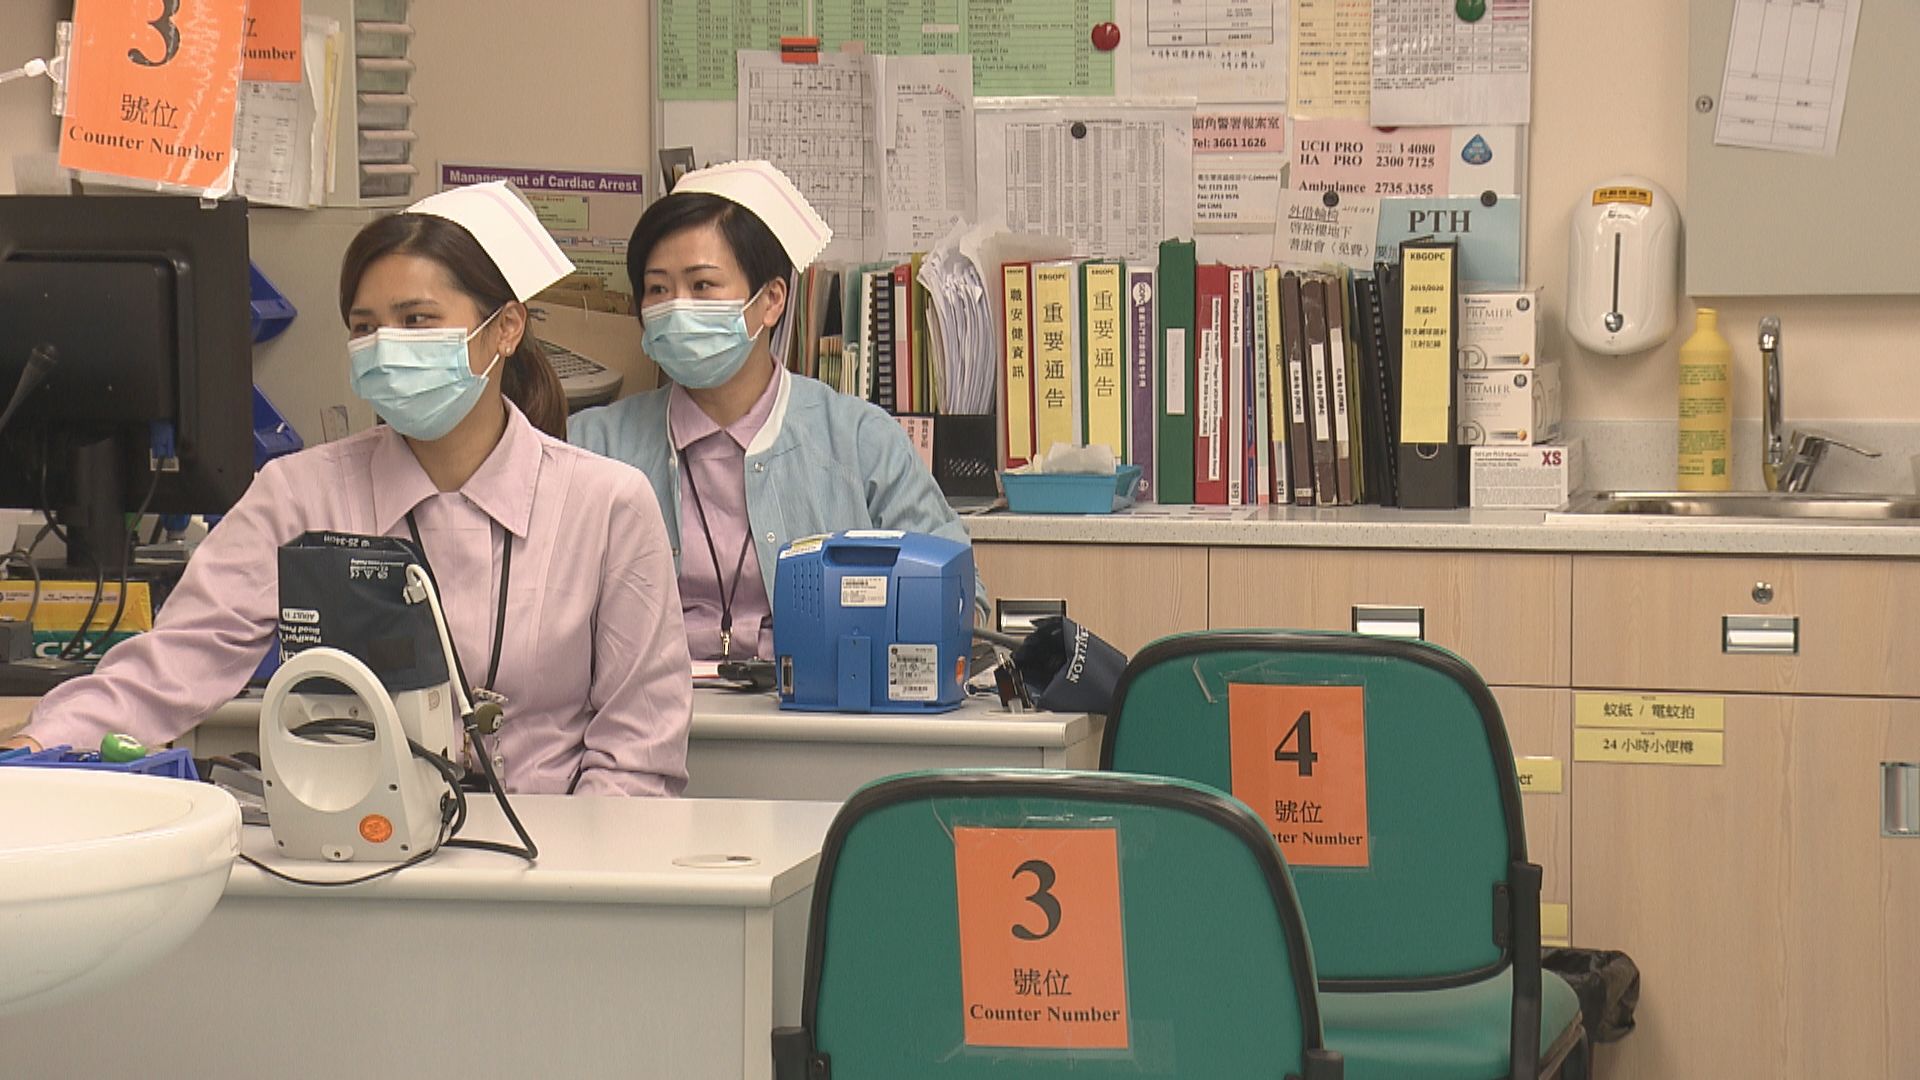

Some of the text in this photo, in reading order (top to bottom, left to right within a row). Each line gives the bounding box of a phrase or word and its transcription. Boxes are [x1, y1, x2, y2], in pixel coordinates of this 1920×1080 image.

[128, 0, 181, 67] 3
[241, 46, 297, 61] umber
[121, 93, 178, 129] 號位
[69, 125, 225, 162] Counter Number
[1213, 138, 1238, 147] 3661
[1242, 138, 1267, 147] 1626
[1301, 140, 1330, 153] UCH
[1335, 141, 1363, 154] PRO
[1408, 143, 1435, 155] 4080
[1301, 154, 1435, 169] HA PRO 2300 7125
[532, 174, 545, 186] of
[548, 175, 596, 190] Cardiac
[599, 177, 638, 191] Arrest
[1298, 180, 1434, 195] Ambulance 2735 3355
[1408, 210, 1471, 234] PTH
[1410, 252, 1446, 261] KBGOPC
[1465, 308, 1512, 319] PREMIER
[1010, 288, 1024, 379] 職安健資訊
[1093, 290, 1115, 397] 重要通告
[1043, 302, 1066, 409] 重要通告
[1464, 384, 1511, 395] PREMIER
[1541, 450, 1562, 466] XS
[1603, 702, 1633, 717] 蚊紙
[1652, 704, 1695, 720] 電蚊拍
[1273, 710, 1318, 777] 4
[1603, 738, 1694, 754] 24 小時小便樽
[1275, 800, 1323, 823] 號位
[1303, 832, 1363, 845] Number
[1010, 859, 1062, 941] 3
[1013, 968, 1072, 997] 號位
[969, 1004, 1121, 1023] Counter Number
